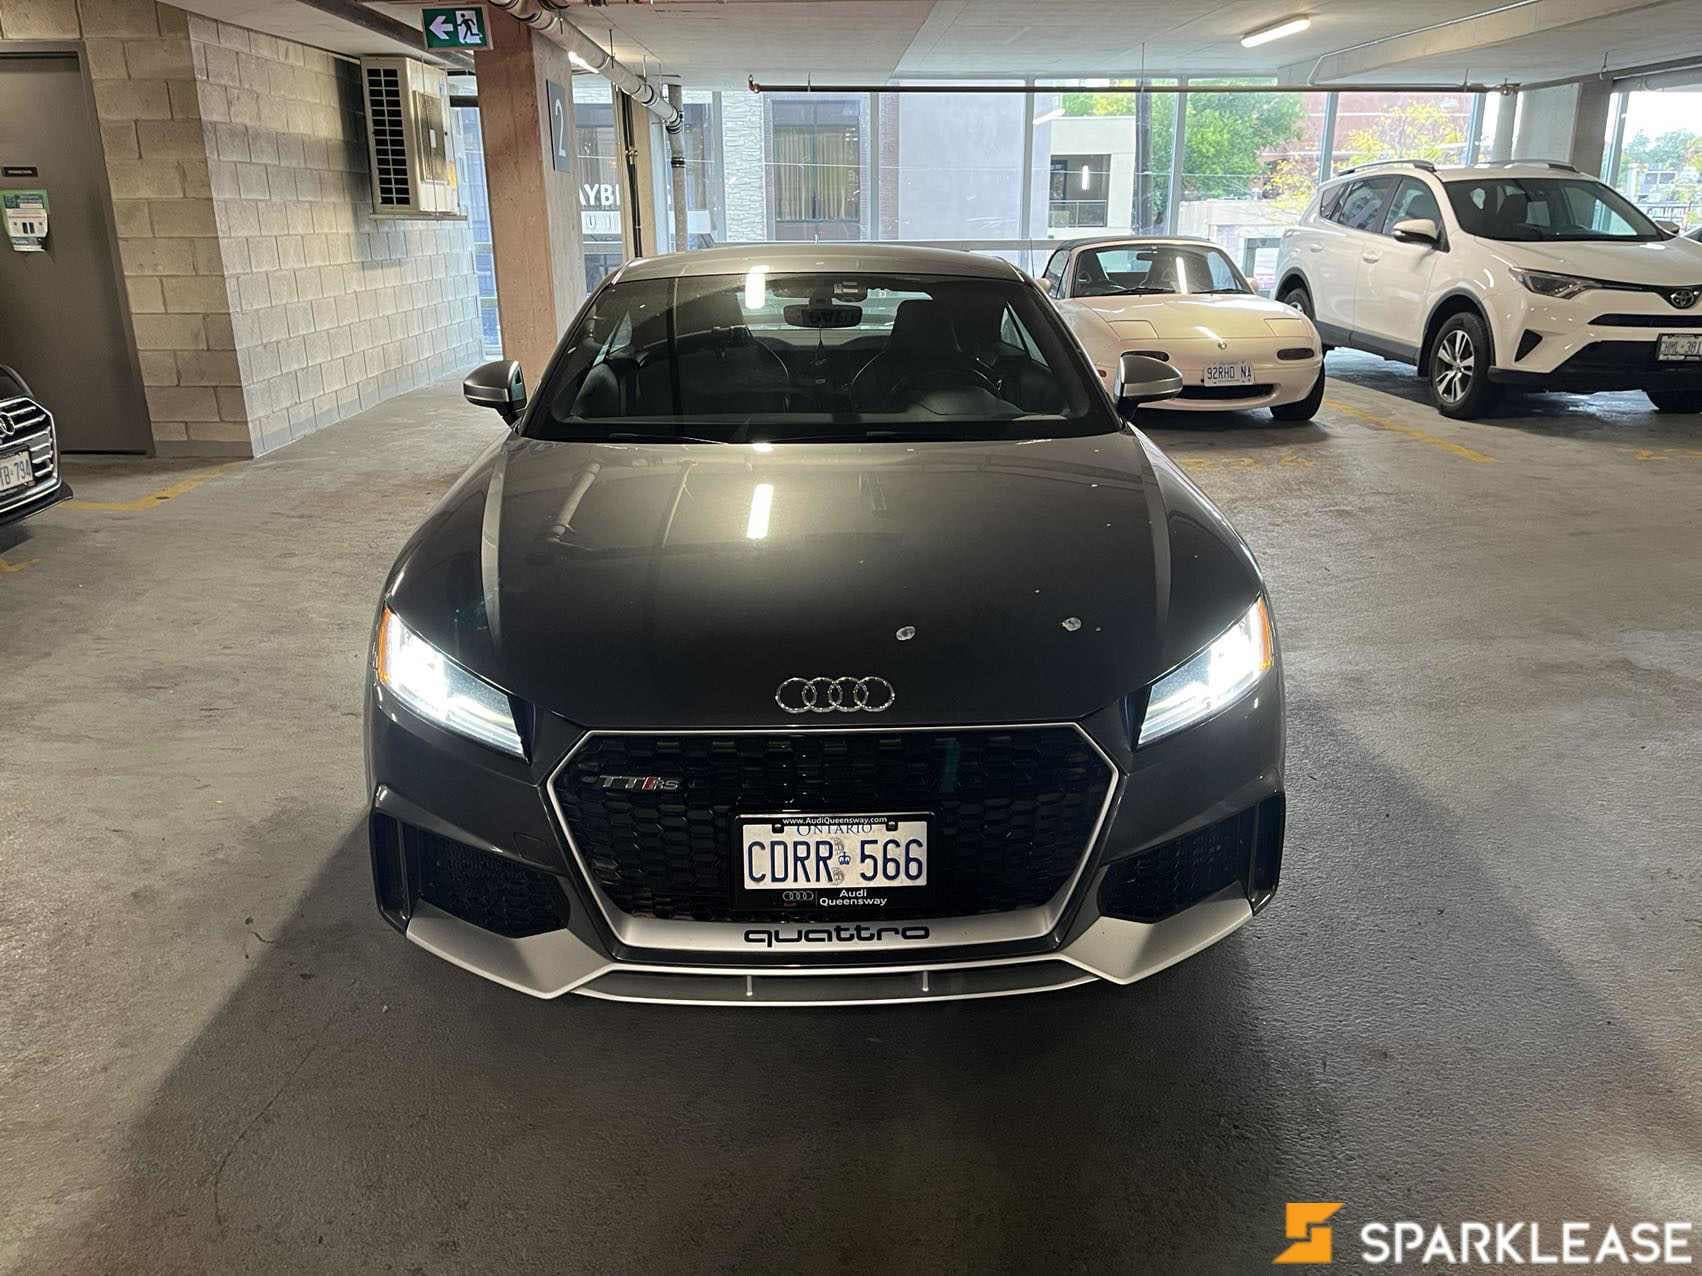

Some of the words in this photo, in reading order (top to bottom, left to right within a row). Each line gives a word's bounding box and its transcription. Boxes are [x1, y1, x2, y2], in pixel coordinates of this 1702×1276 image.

[555, 98, 567, 158] 2
[782, 816, 888, 826] www.AudiQueensway.com
[797, 824, 873, 836] ONTARIO
[747, 840, 834, 884] CDRR
[859, 838, 923, 882] 566
[839, 888, 867, 898] Audi
[819, 896, 888, 907] Queensway
[743, 924, 930, 948] quattro
